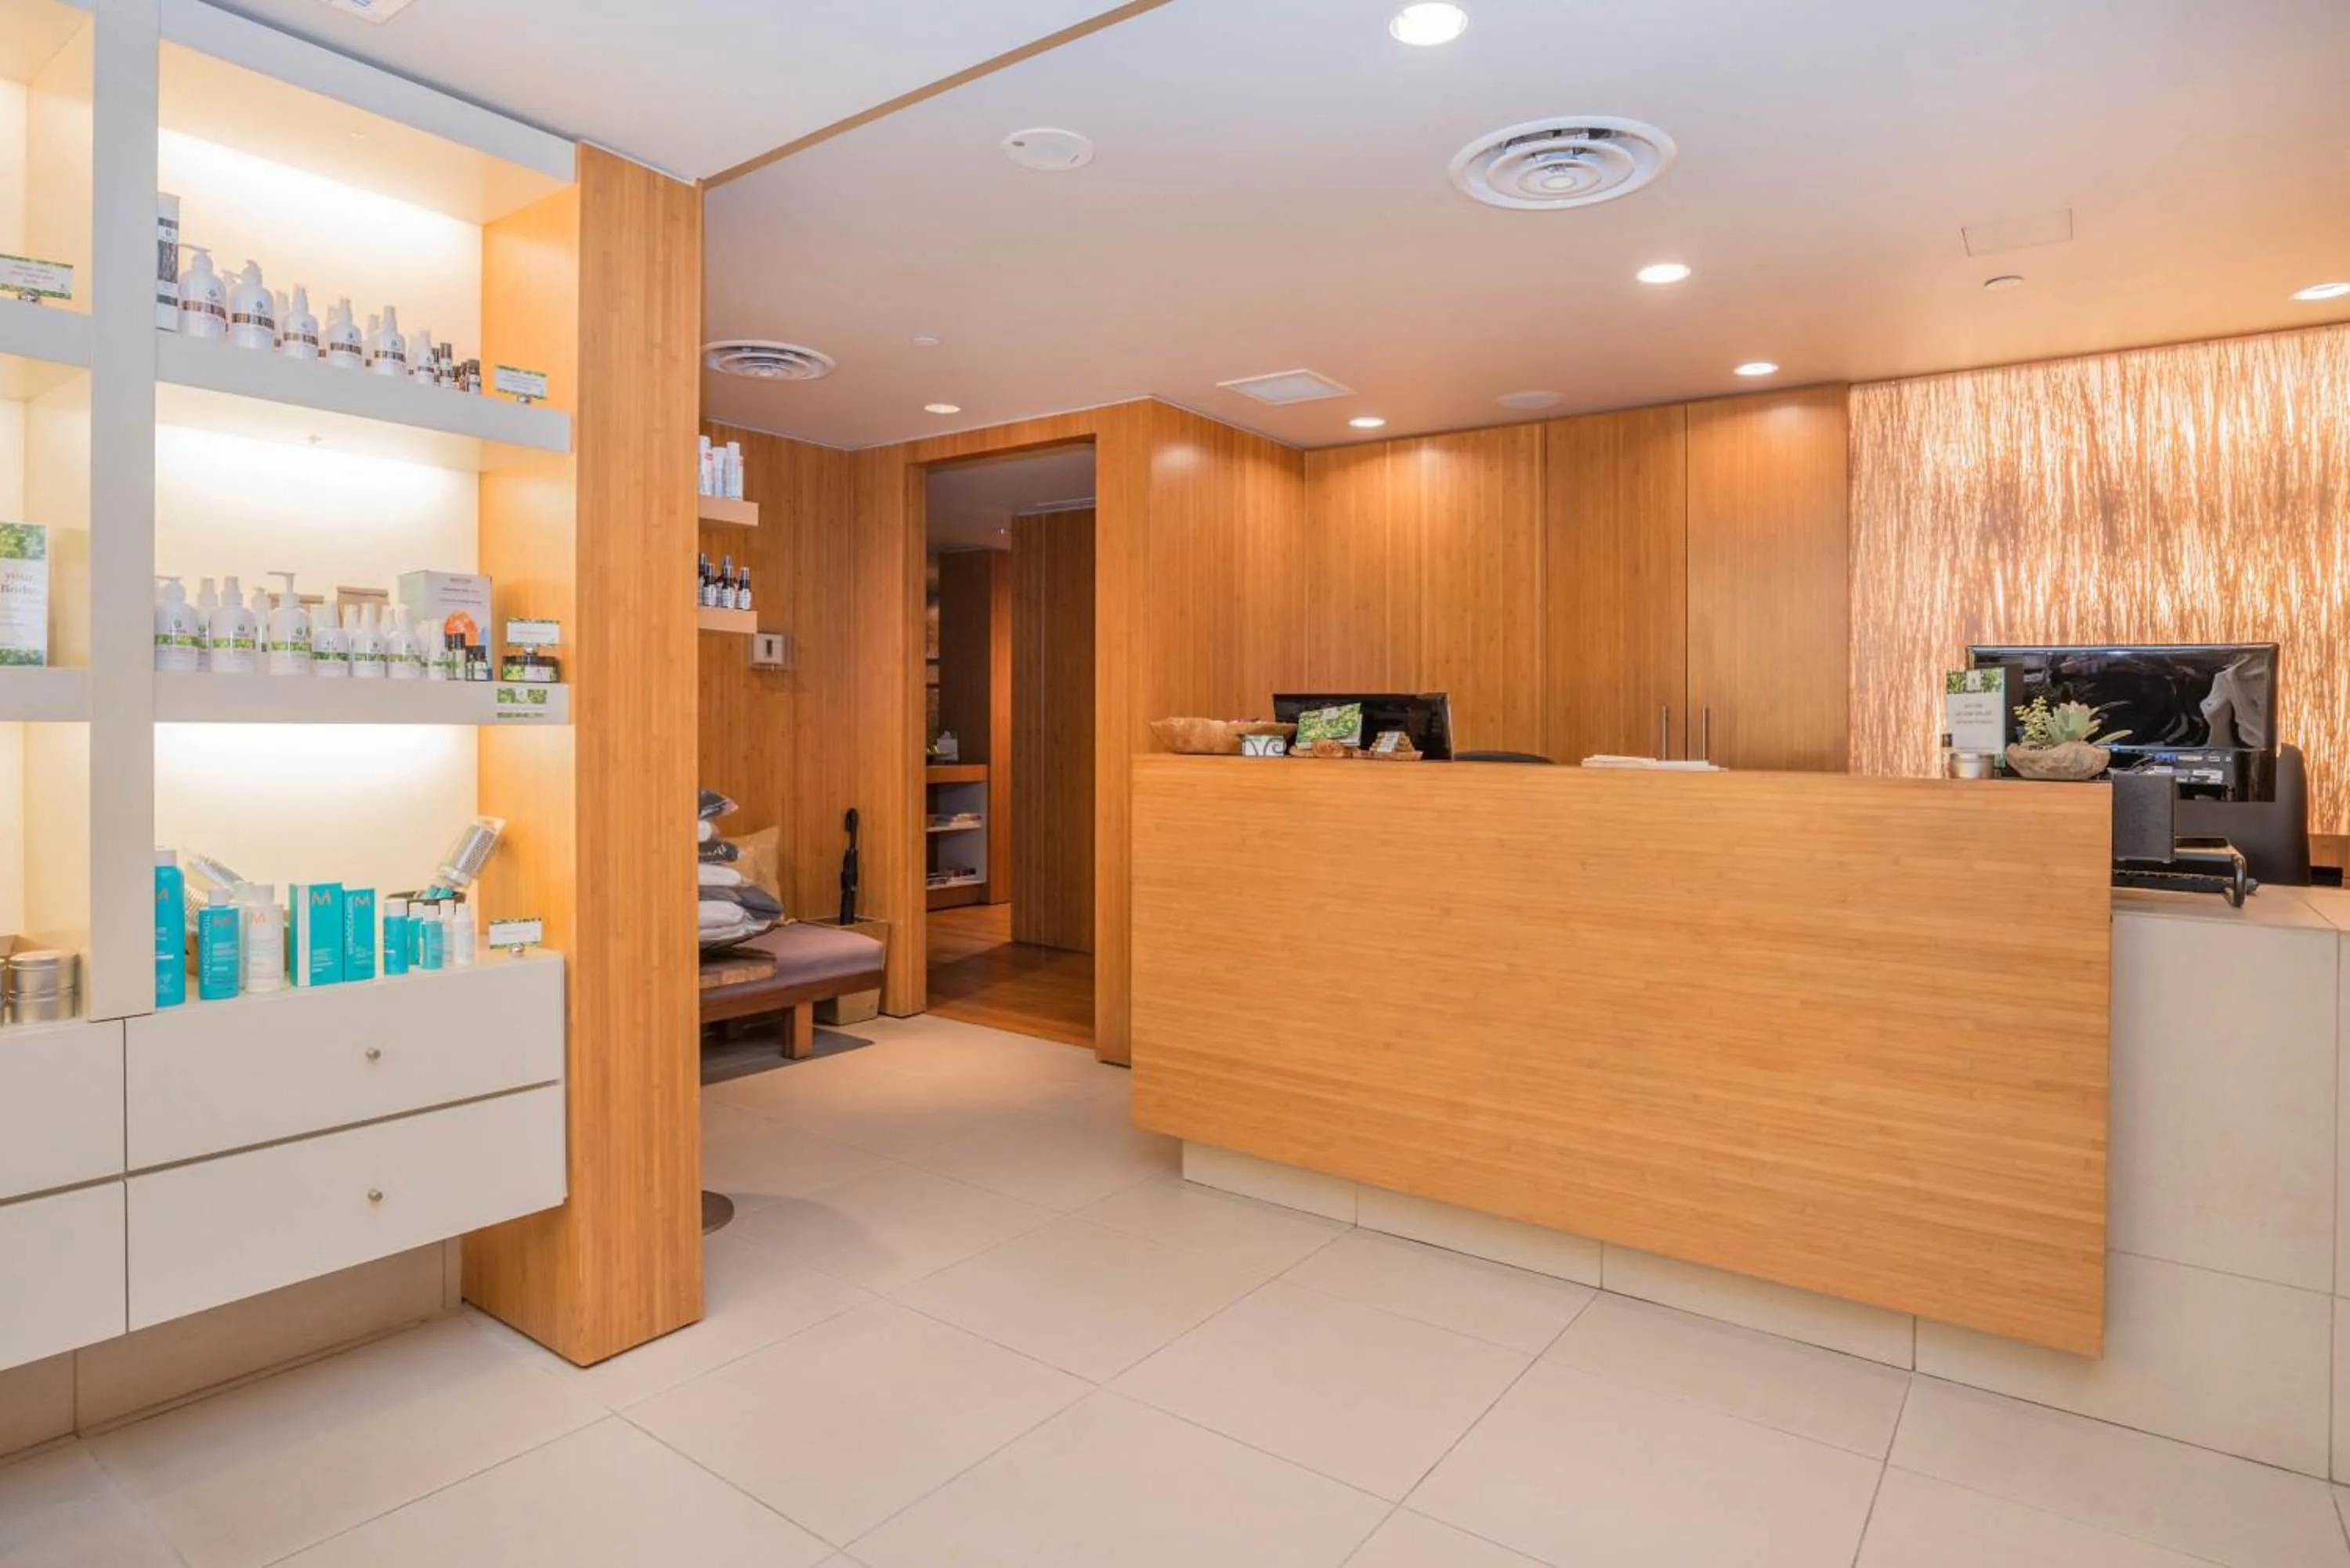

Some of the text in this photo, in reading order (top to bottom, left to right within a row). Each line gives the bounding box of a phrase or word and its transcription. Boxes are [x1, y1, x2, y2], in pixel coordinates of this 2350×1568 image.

[311, 889, 331, 905] M
[354, 894, 371, 906] M
[251, 912, 266, 925] M
